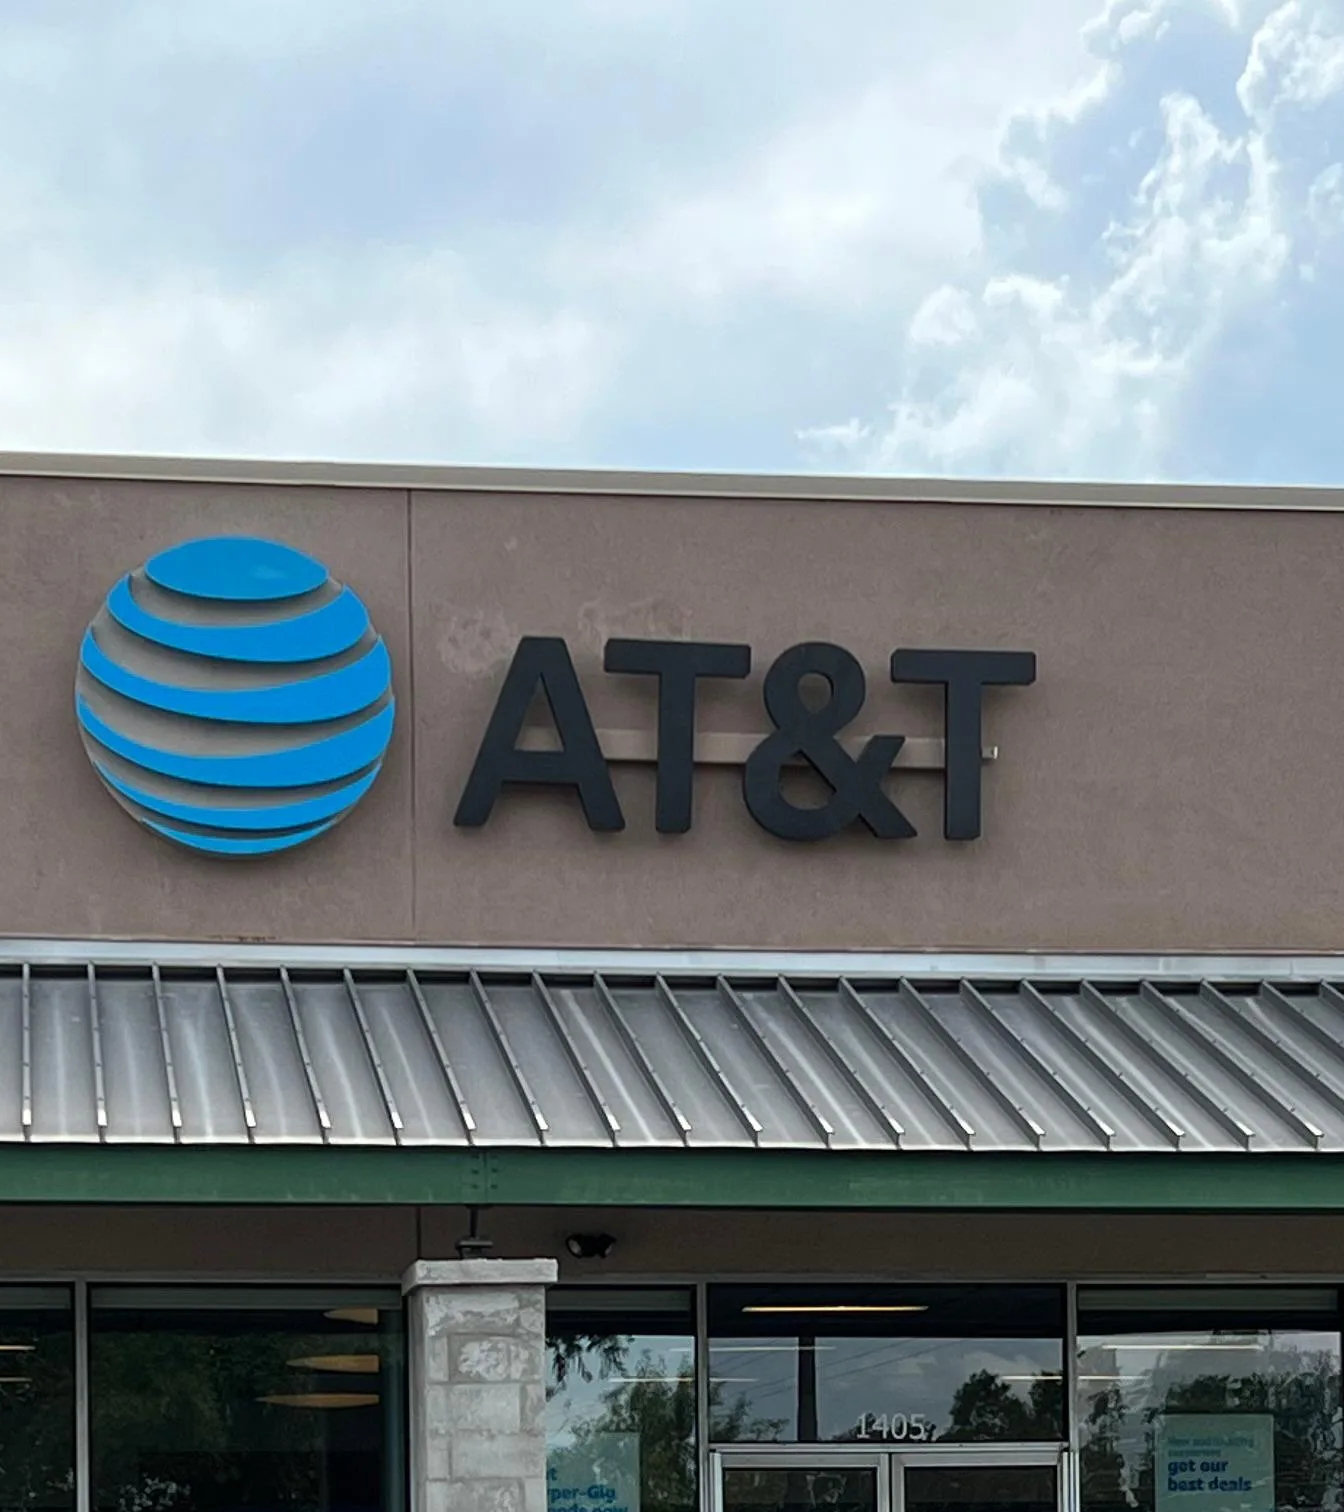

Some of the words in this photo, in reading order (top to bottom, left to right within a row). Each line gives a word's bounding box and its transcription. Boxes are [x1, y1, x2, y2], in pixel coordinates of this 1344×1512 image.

[453, 635, 1037, 842] AT&T
[857, 1412, 926, 1440] 1405
[1168, 1460, 1196, 1475] get
[1200, 1461, 1229, 1472] our
[1168, 1477, 1203, 1491] best
[1207, 1476, 1252, 1491] deals
